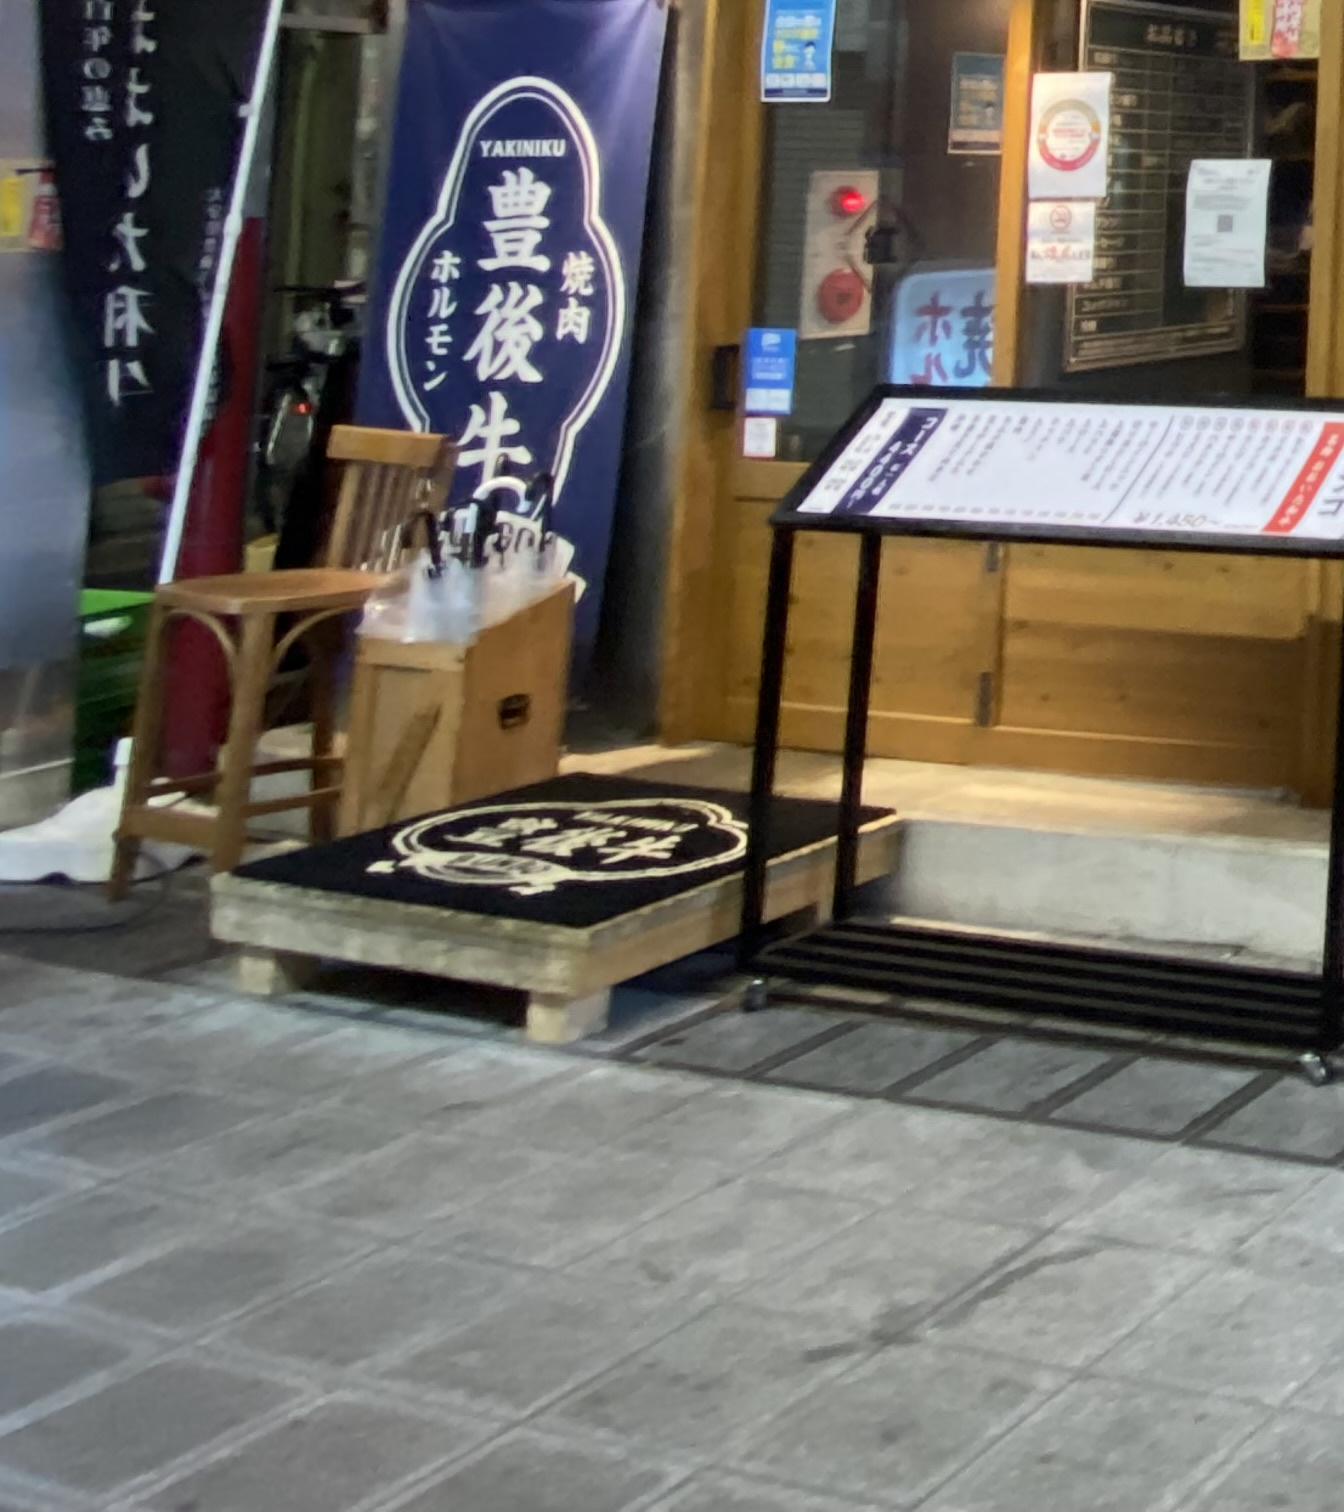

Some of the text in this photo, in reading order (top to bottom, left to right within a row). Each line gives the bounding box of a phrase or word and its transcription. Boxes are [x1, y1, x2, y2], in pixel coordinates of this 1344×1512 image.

[479, 139, 567, 158] YAKINIKU
[424, 251, 462, 391] ホルモン
[457, 166, 552, 486] 豊後牛
[555, 251, 596, 345] 焼肉
[899, 416, 938, 456] コース
